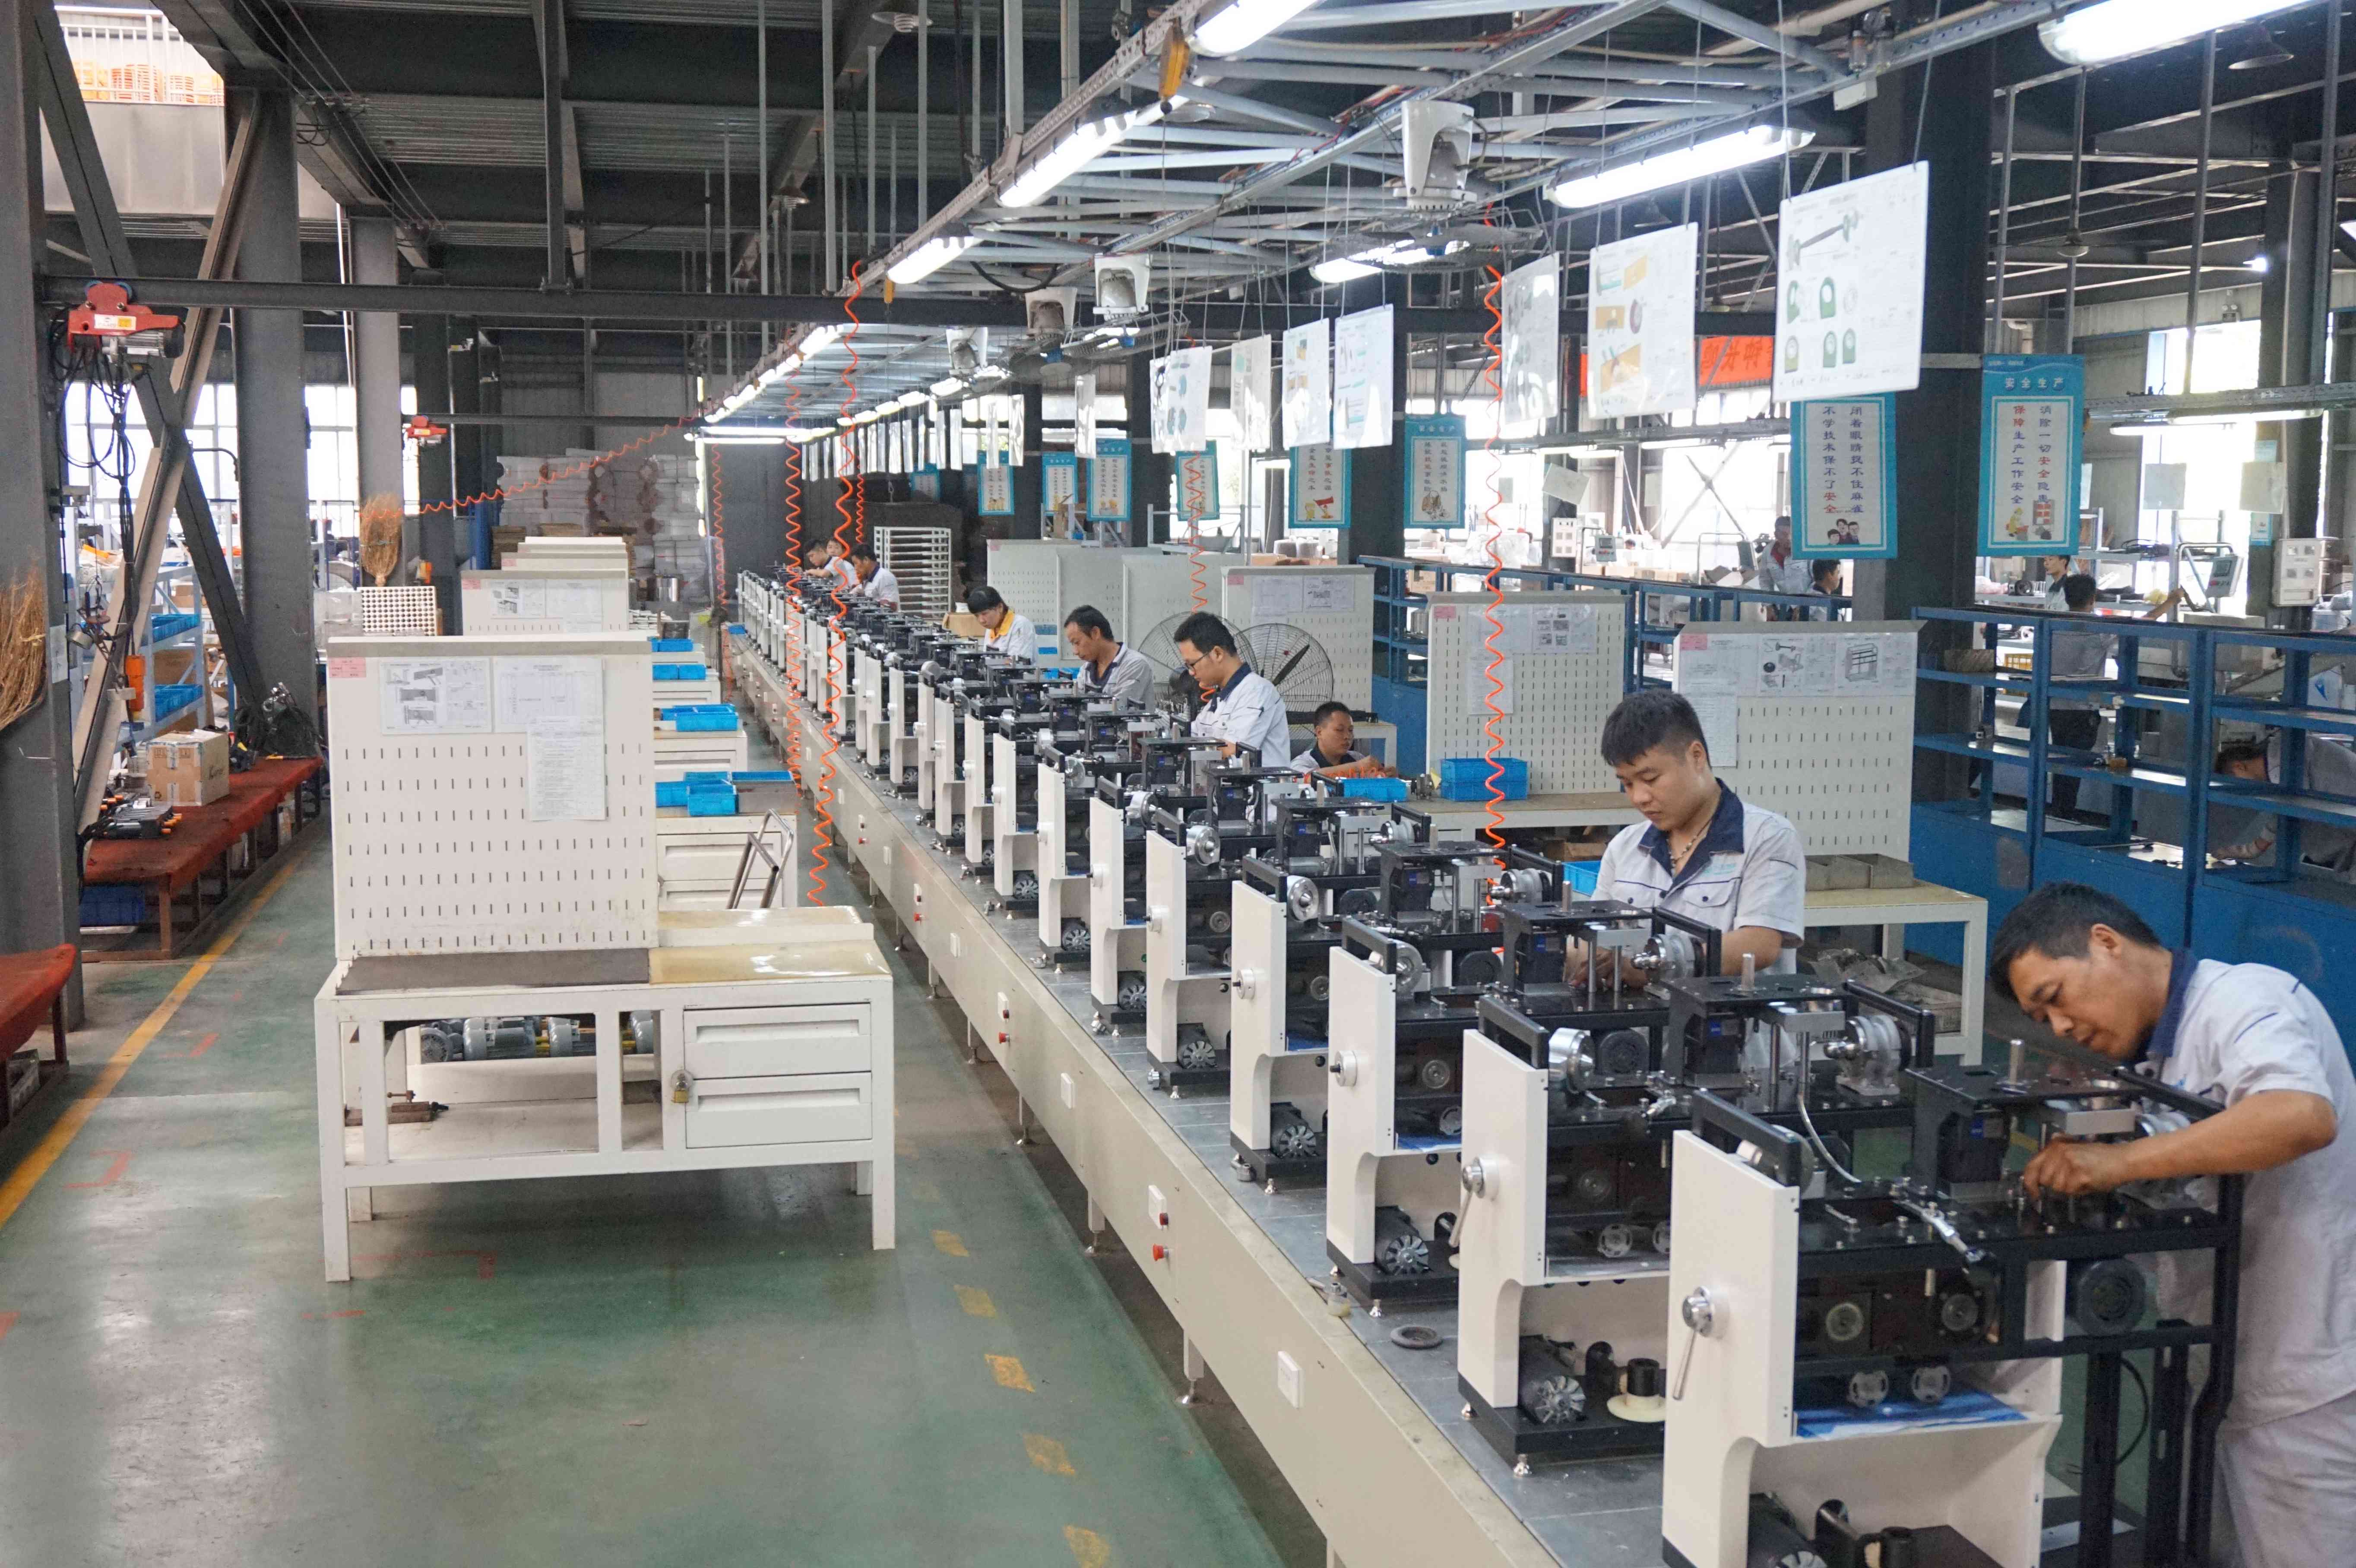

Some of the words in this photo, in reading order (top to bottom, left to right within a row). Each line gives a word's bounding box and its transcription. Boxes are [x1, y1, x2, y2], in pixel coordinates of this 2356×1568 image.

[2005, 377, 2064, 389] 安全生产
[1823, 406, 1837, 514] 不学技术保不了安全
[1850, 406, 1864, 513] 闭着眼睛捉不住麻雀
[2011, 405, 2026, 504] 保障生产工作安全
[2037, 405, 2052, 503] 消除一切安全隐患
